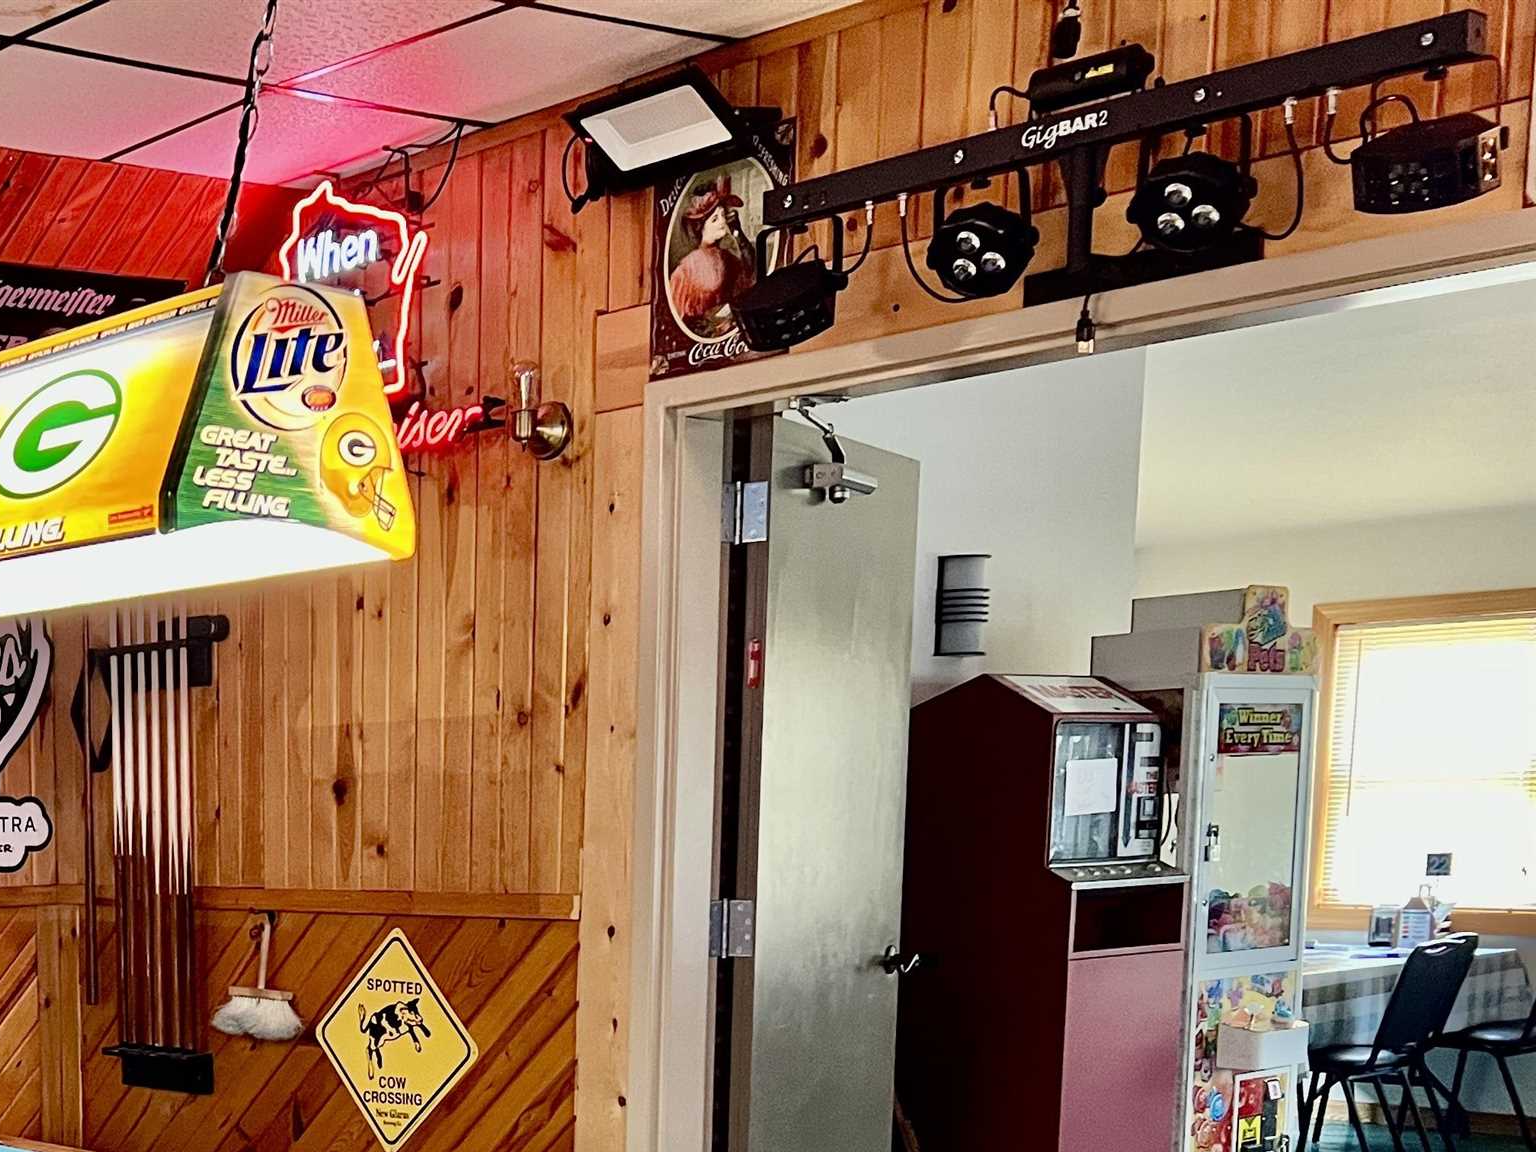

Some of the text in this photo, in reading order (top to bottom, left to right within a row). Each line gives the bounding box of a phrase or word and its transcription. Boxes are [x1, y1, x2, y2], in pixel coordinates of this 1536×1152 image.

[297, 229, 378, 283] When
[265, 297, 329, 324] Miller
[239, 328, 344, 394] Lite
[689, 331, 751, 366] Coca-Co
[200, 424, 278, 452] GREAT
[192, 466, 256, 491] LESS
[1427, 855, 1451, 874] 22
[367, 978, 423, 995] SPOTTED
[379, 1076, 406, 1089] COW
[363, 1091, 422, 1106] CROSSING
[376, 1109, 388, 1118] New
